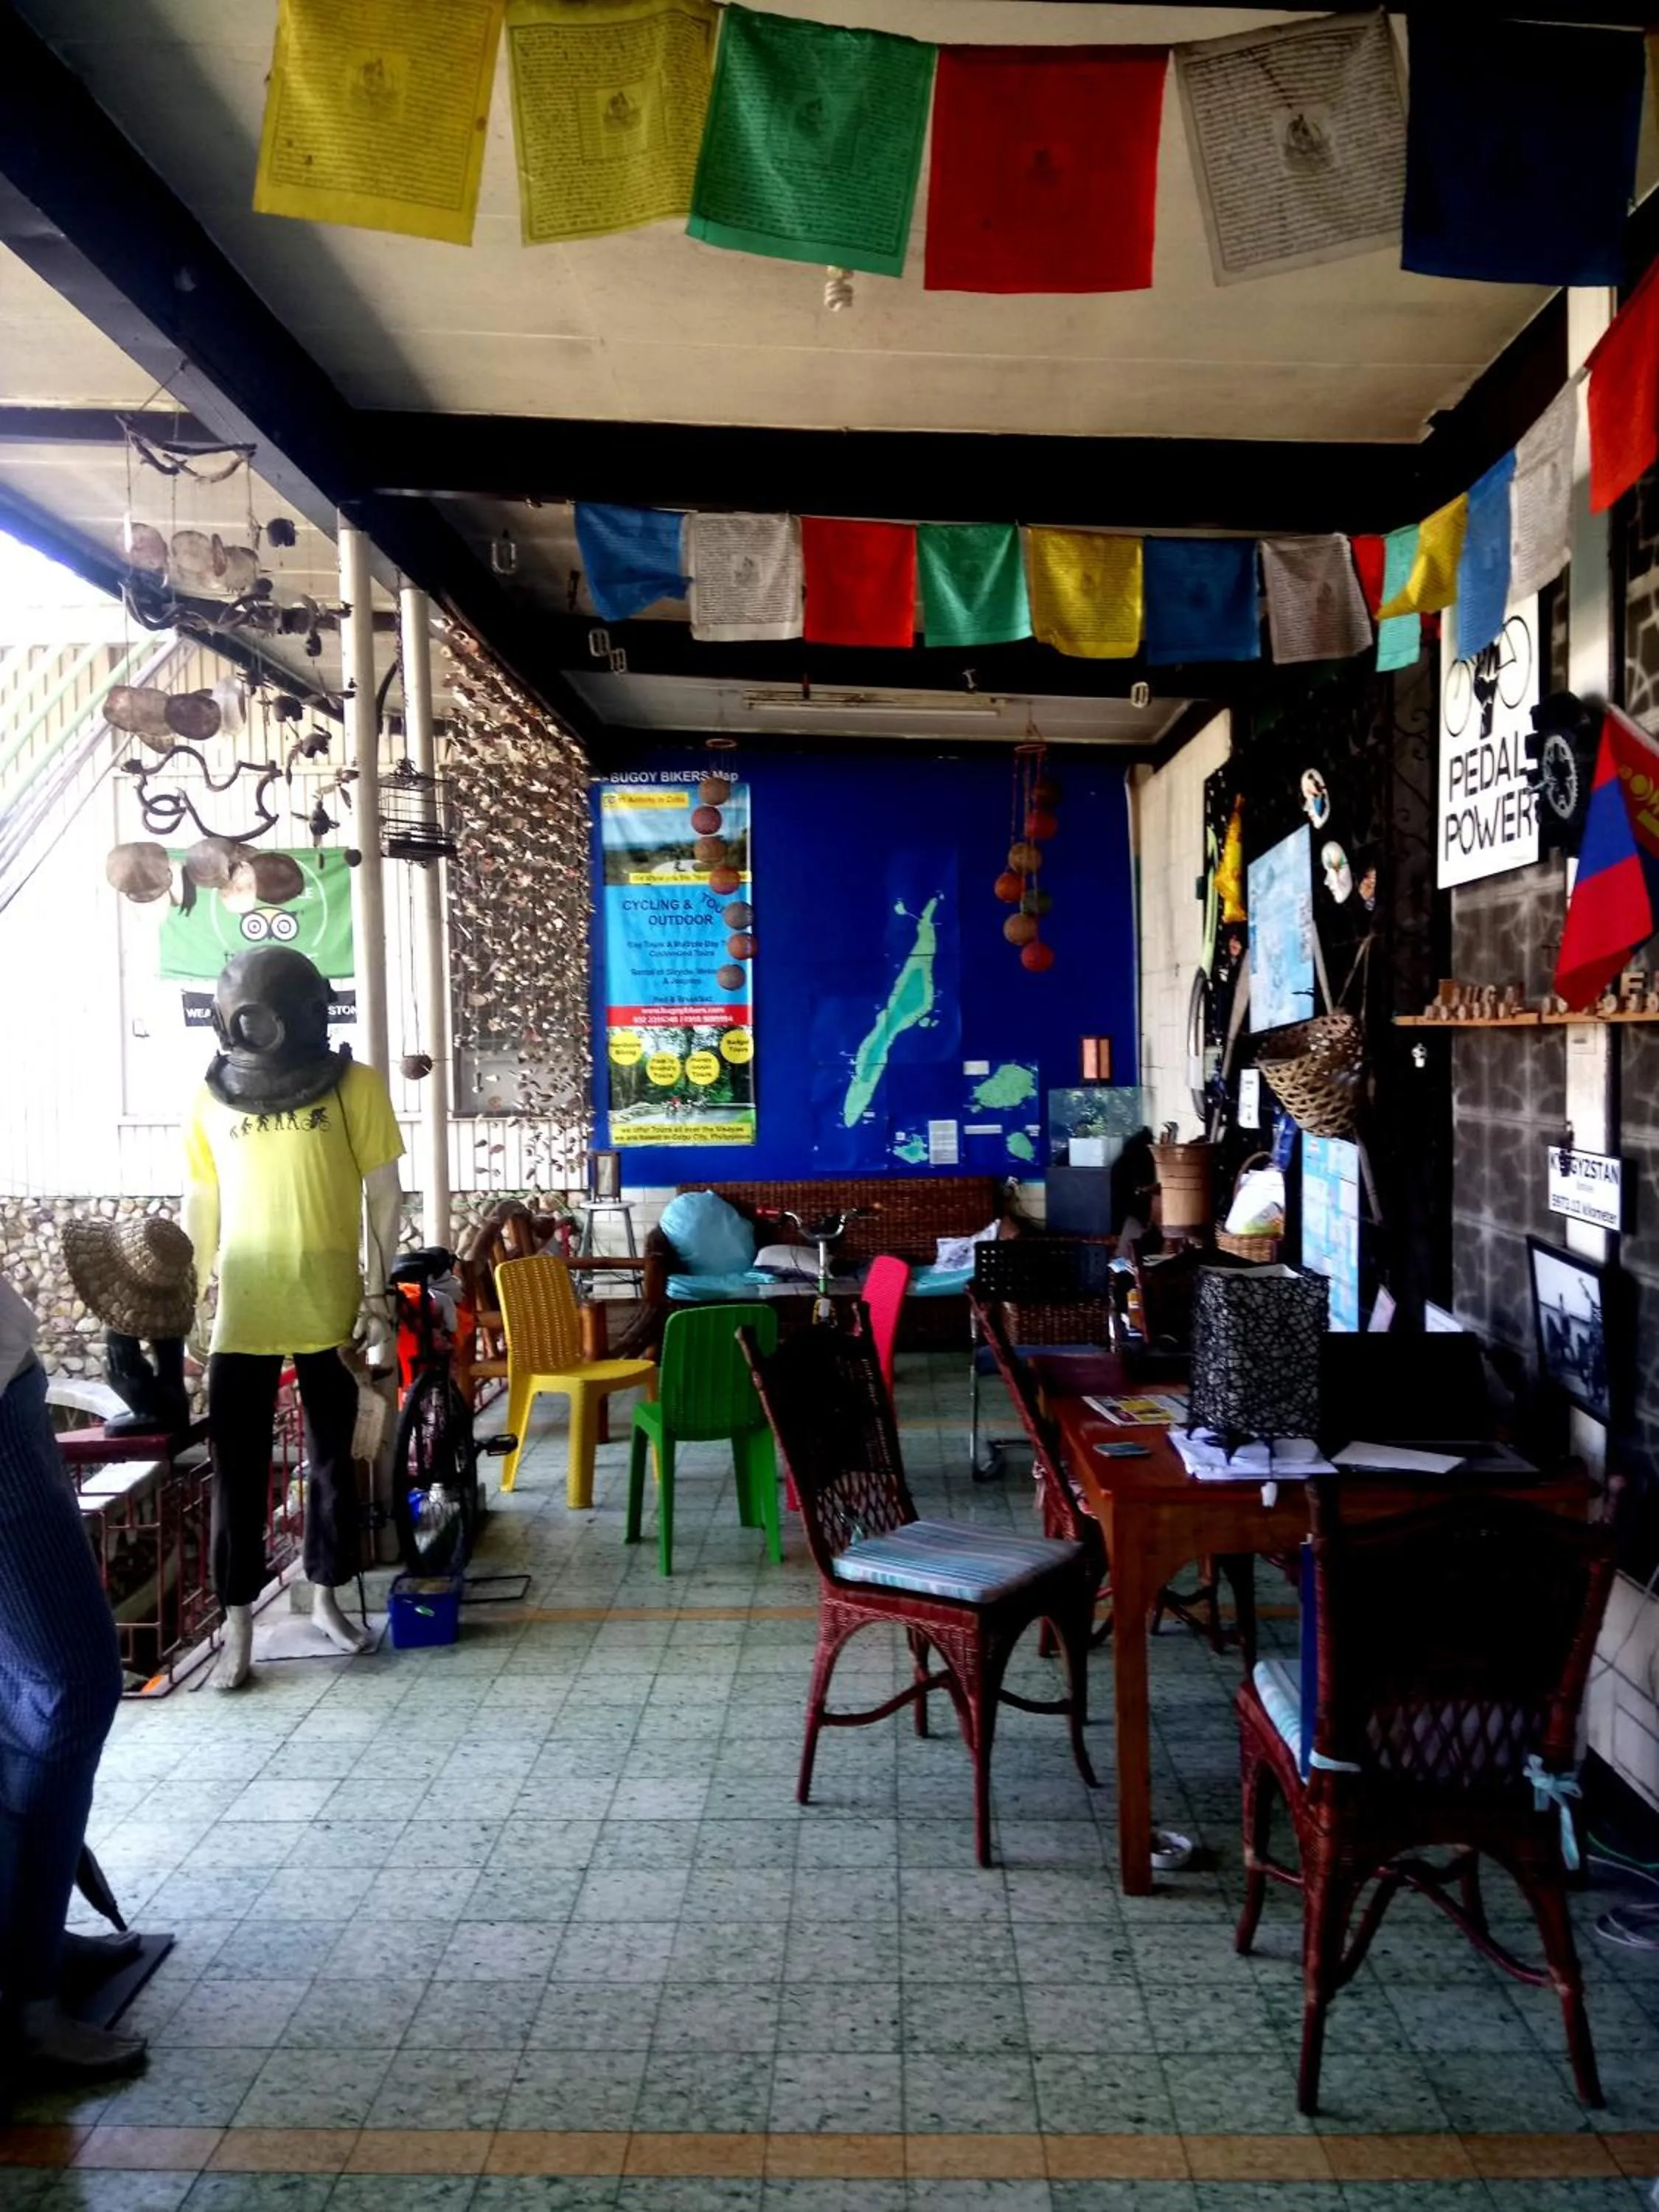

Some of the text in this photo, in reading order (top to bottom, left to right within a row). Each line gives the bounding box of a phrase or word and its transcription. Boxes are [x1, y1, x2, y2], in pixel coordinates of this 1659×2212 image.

[610, 772, 657, 783] BUGOY
[661, 771, 709, 782] BIKERS
[1449, 730, 1527, 803] PEDAL
[1445, 789, 1532, 862] POWER
[623, 900, 692, 911] CYCLING &
[701, 892, 722, 914] TOU
[648, 914, 714, 925] OUTDOOR
[1549, 1152, 1620, 1186] KGYZSTAN
